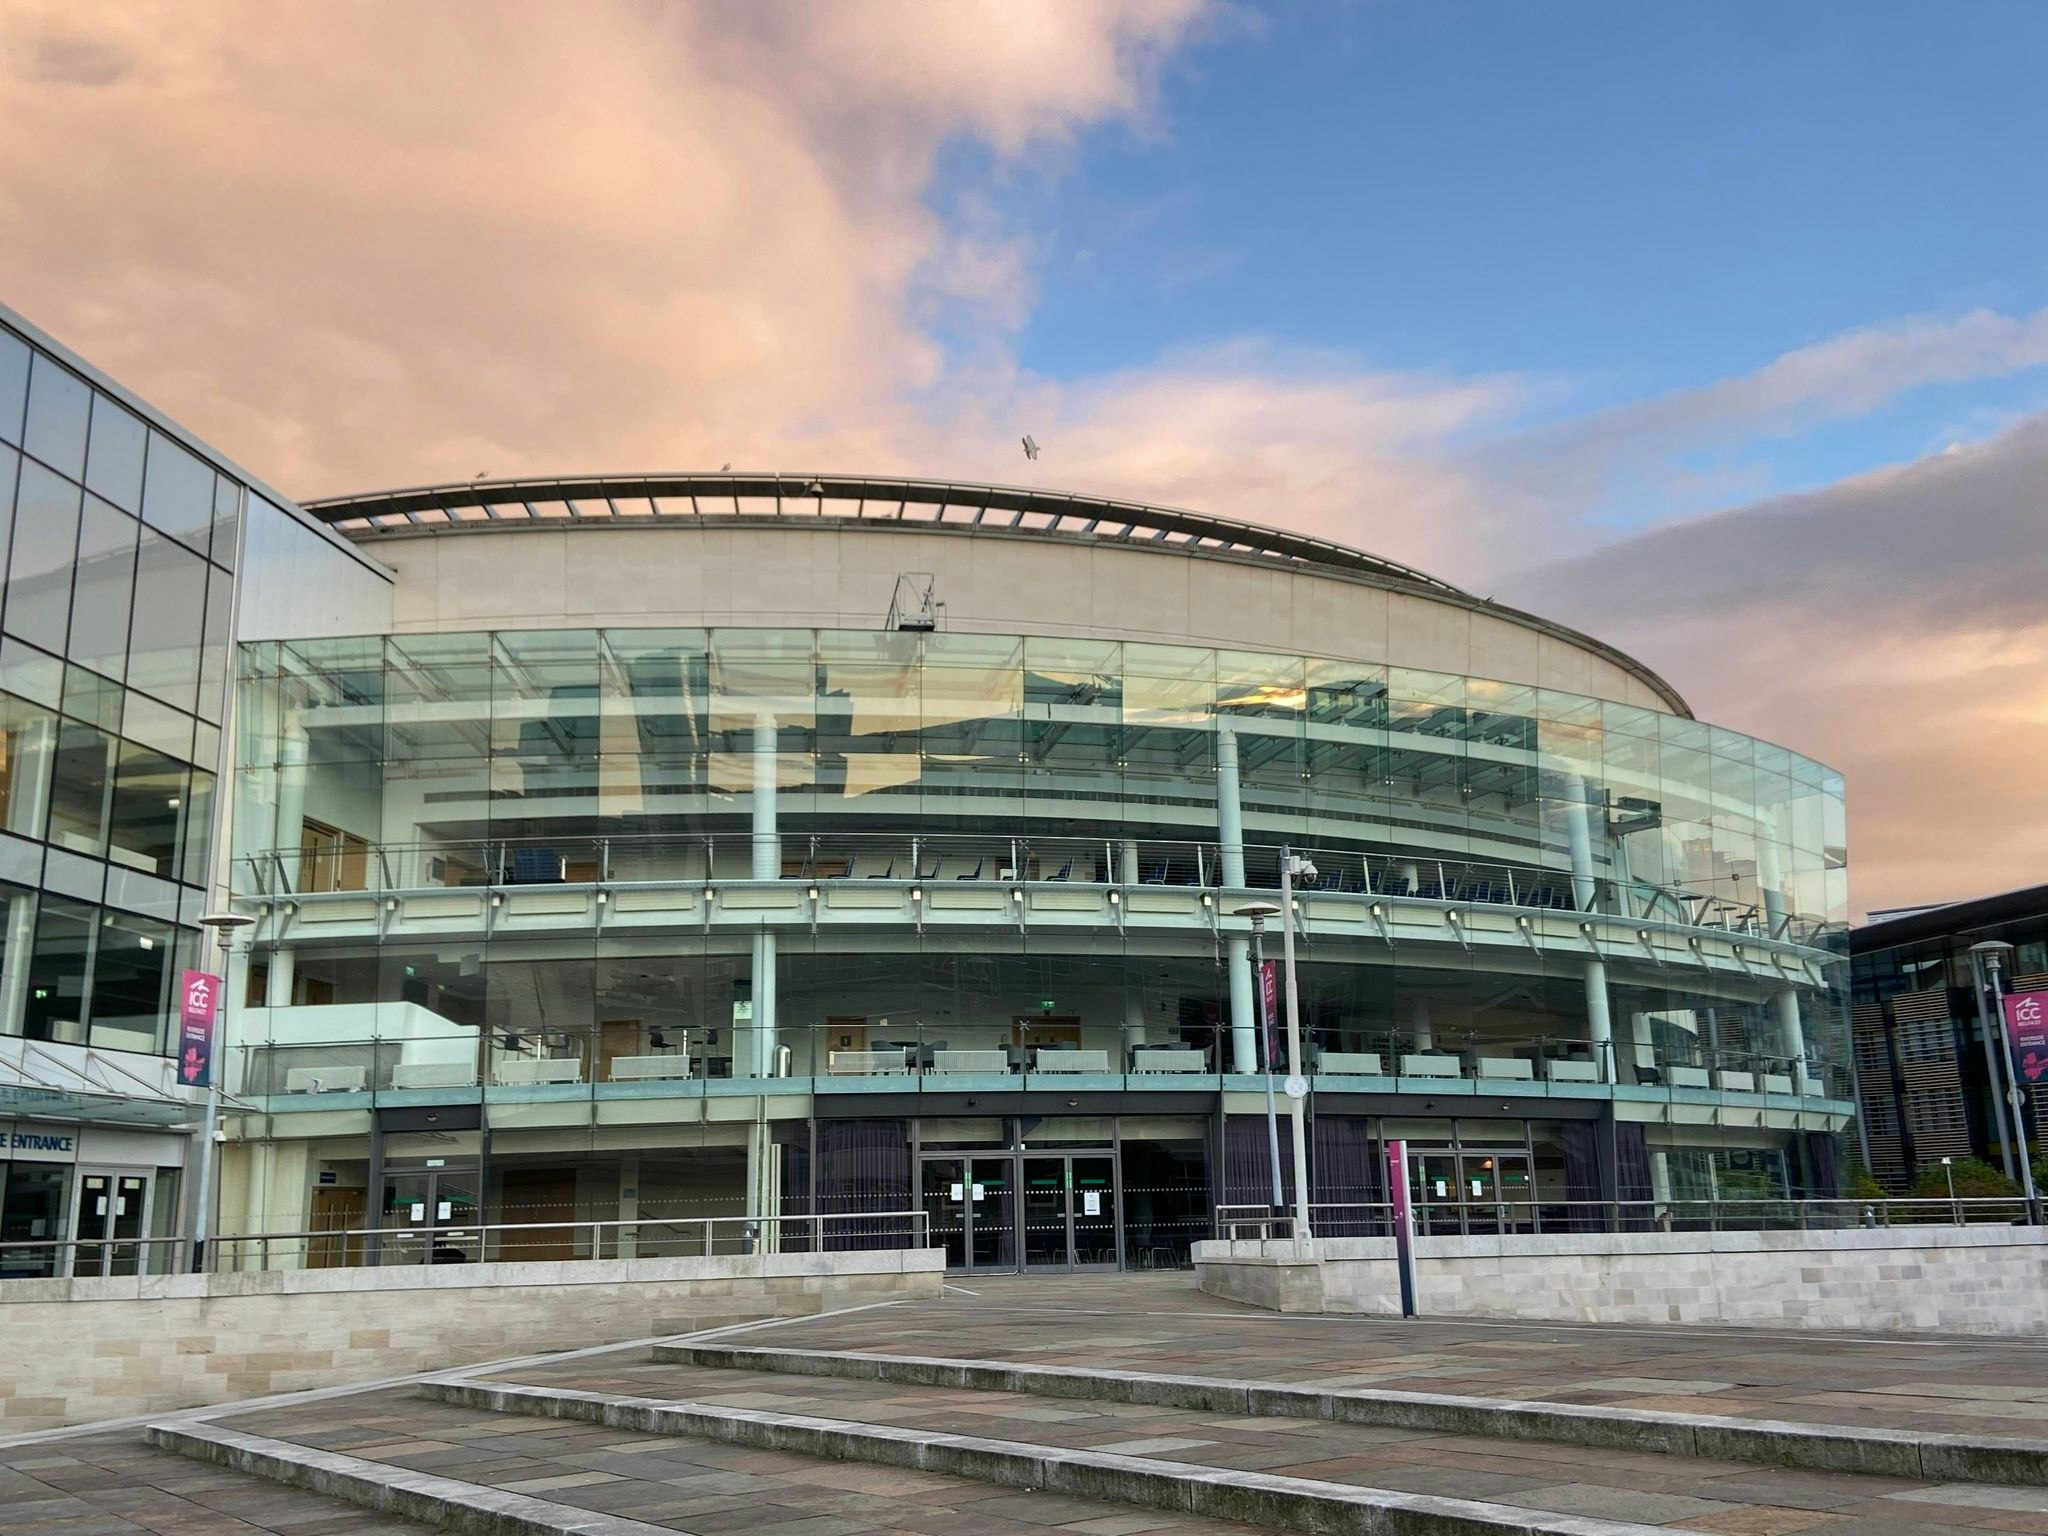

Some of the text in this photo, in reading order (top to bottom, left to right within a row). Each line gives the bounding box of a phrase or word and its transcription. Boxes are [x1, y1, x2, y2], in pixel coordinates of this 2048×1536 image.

[189, 991, 209, 1008] ICC
[2016, 1007, 2042, 1021] ICC
[11, 1133, 73, 1151] ENTRANCE
